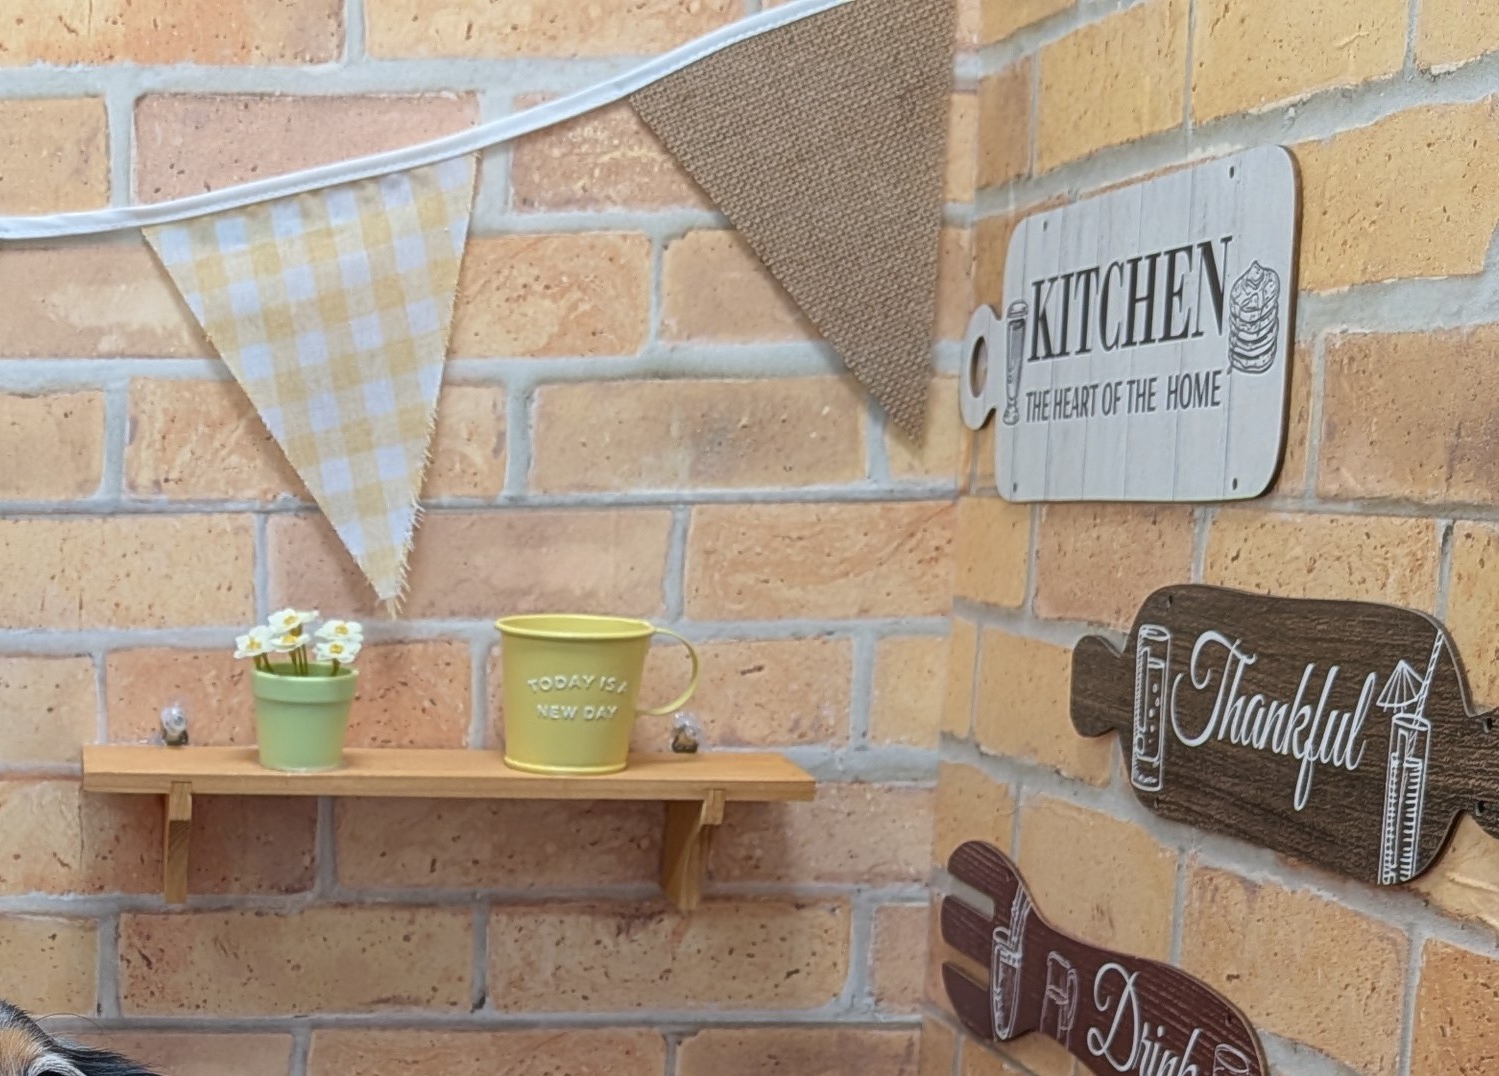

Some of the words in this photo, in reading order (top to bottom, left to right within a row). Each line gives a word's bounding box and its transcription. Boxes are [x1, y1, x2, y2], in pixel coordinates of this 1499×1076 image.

[1027, 235, 1233, 363] KITCHEN
[1025, 390, 1050, 423] THE
[1053, 383, 1099, 420] HEART
[1101, 381, 1123, 417] OF
[1127, 377, 1158, 414] THE
[1167, 370, 1223, 411] HOME
[527, 674, 595, 694] TODAY
[600, 676, 615, 692] IS
[536, 703, 578, 721] NEW
[583, 704, 618, 721] DAY
[1170, 629, 1377, 812] Thankful
